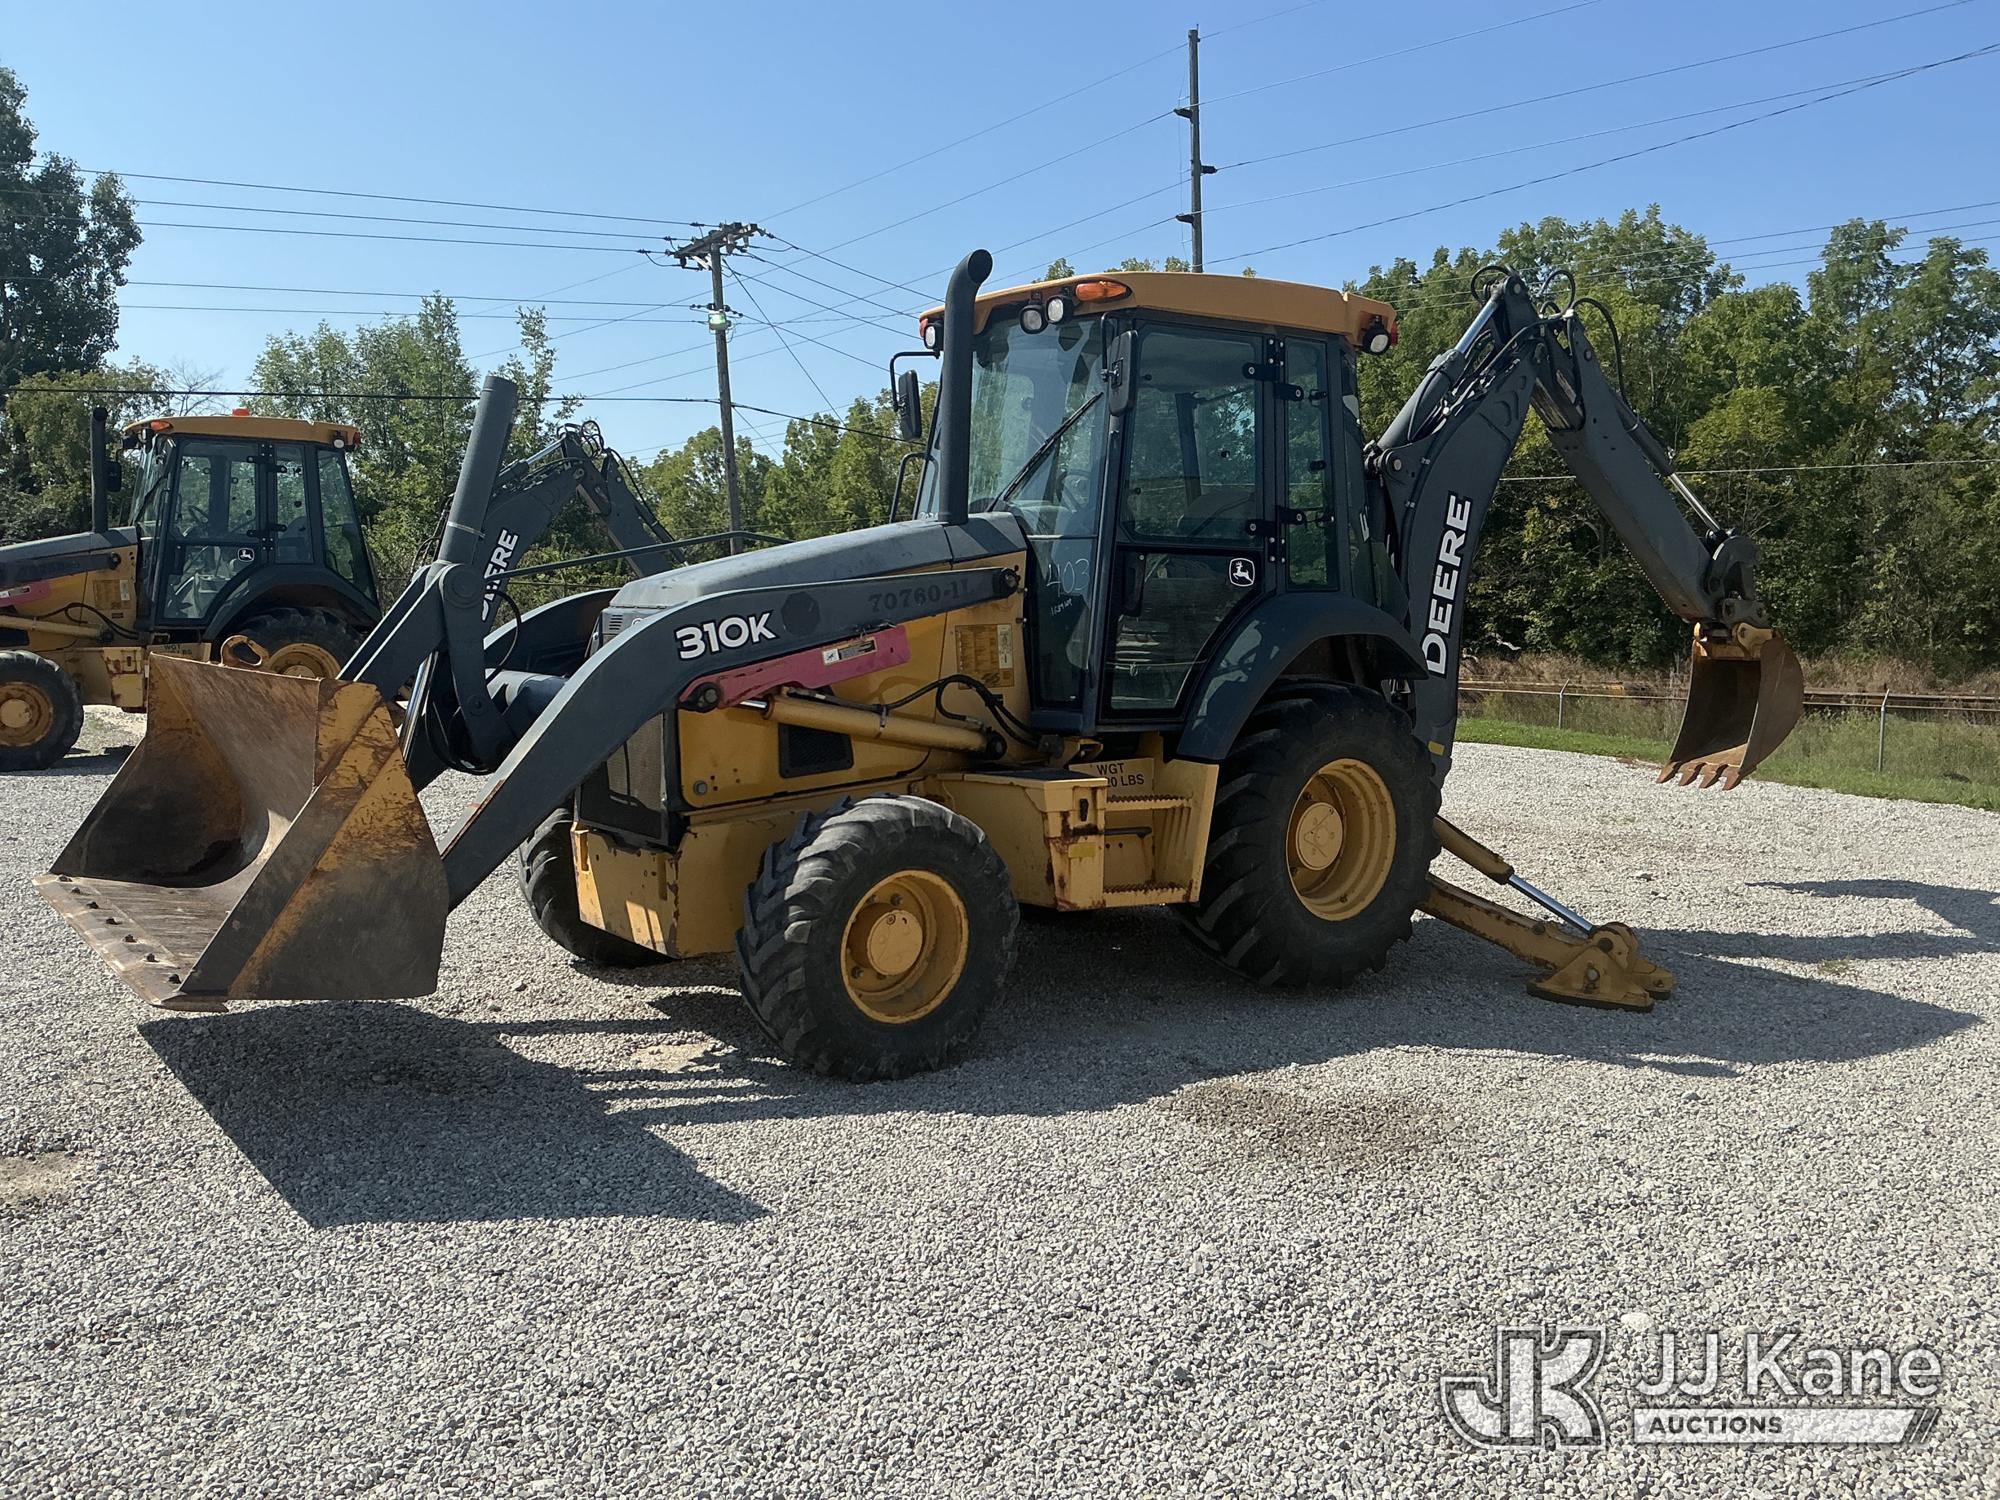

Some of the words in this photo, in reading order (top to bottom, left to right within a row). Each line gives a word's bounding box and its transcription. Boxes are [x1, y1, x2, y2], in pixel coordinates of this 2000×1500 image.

[1046, 558, 1090, 597] 403
[1422, 495, 1471, 675] DEERE
[676, 613, 776, 659] 310K
[1096, 763, 1124, 775] WGT
[1120, 774, 1145, 787] LBS
